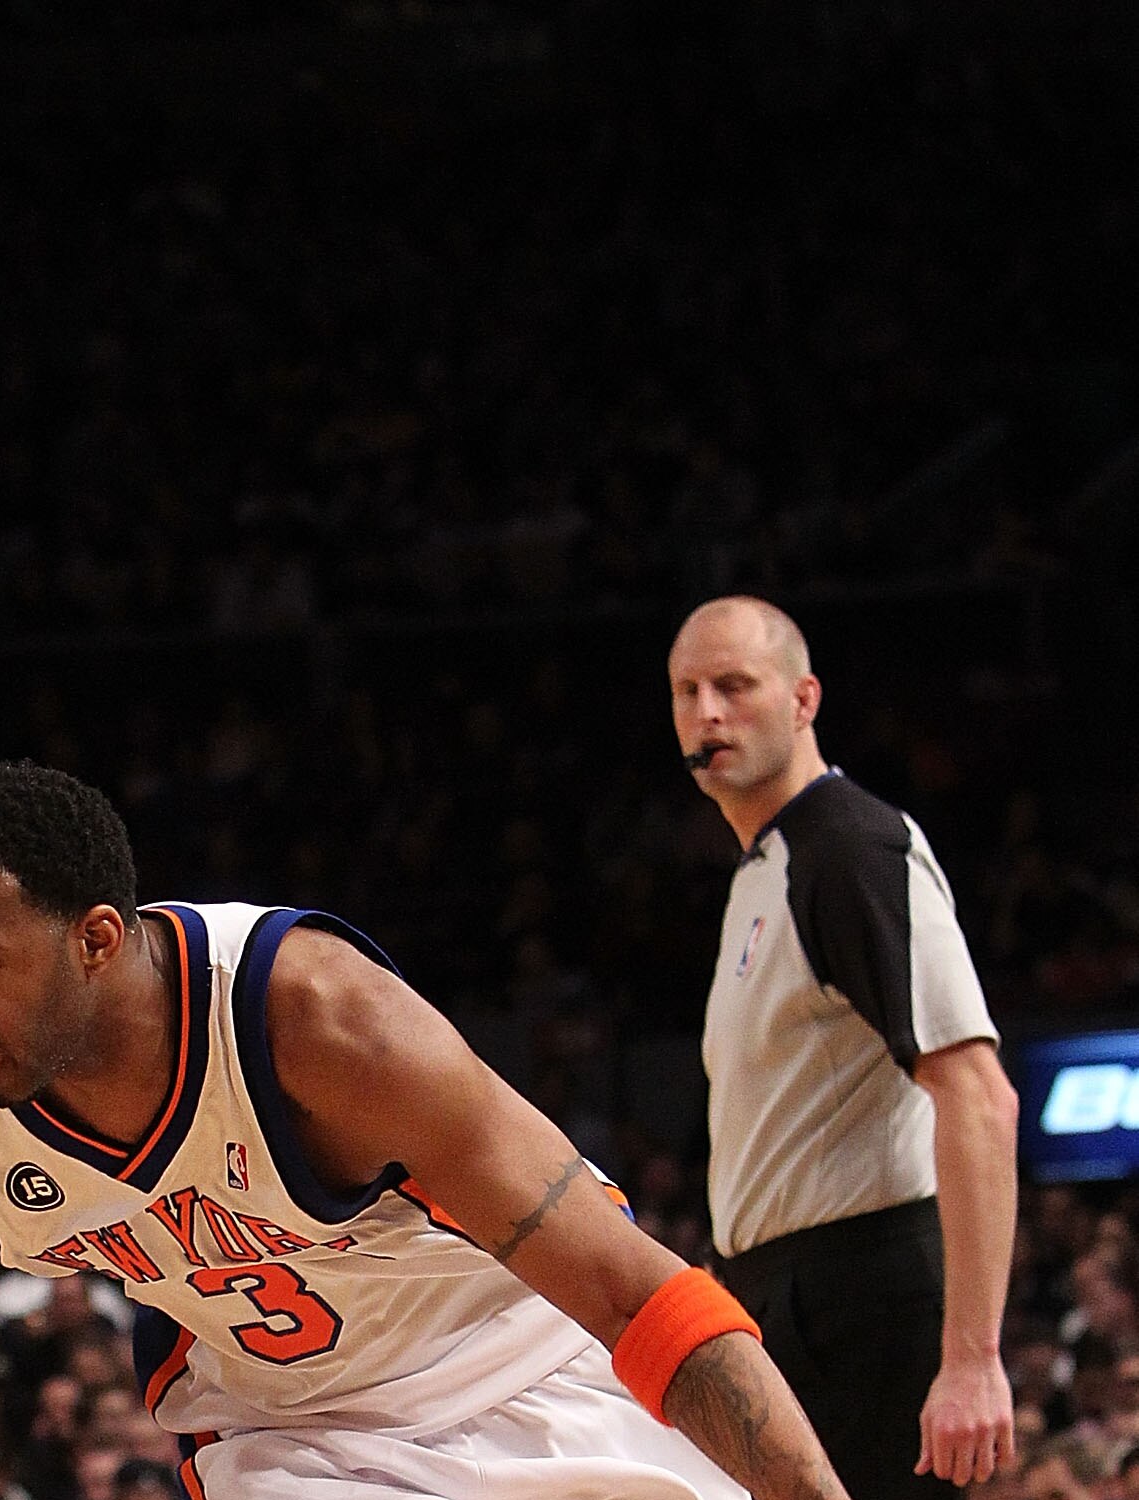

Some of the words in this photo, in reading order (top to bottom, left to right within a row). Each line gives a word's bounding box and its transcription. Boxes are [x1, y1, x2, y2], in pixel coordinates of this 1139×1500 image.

[20, 1175, 54, 1201] 15
[26, 1219, 166, 1284] EW
[144, 1185, 359, 1268] YOR
[186, 1262, 344, 1366] 3
